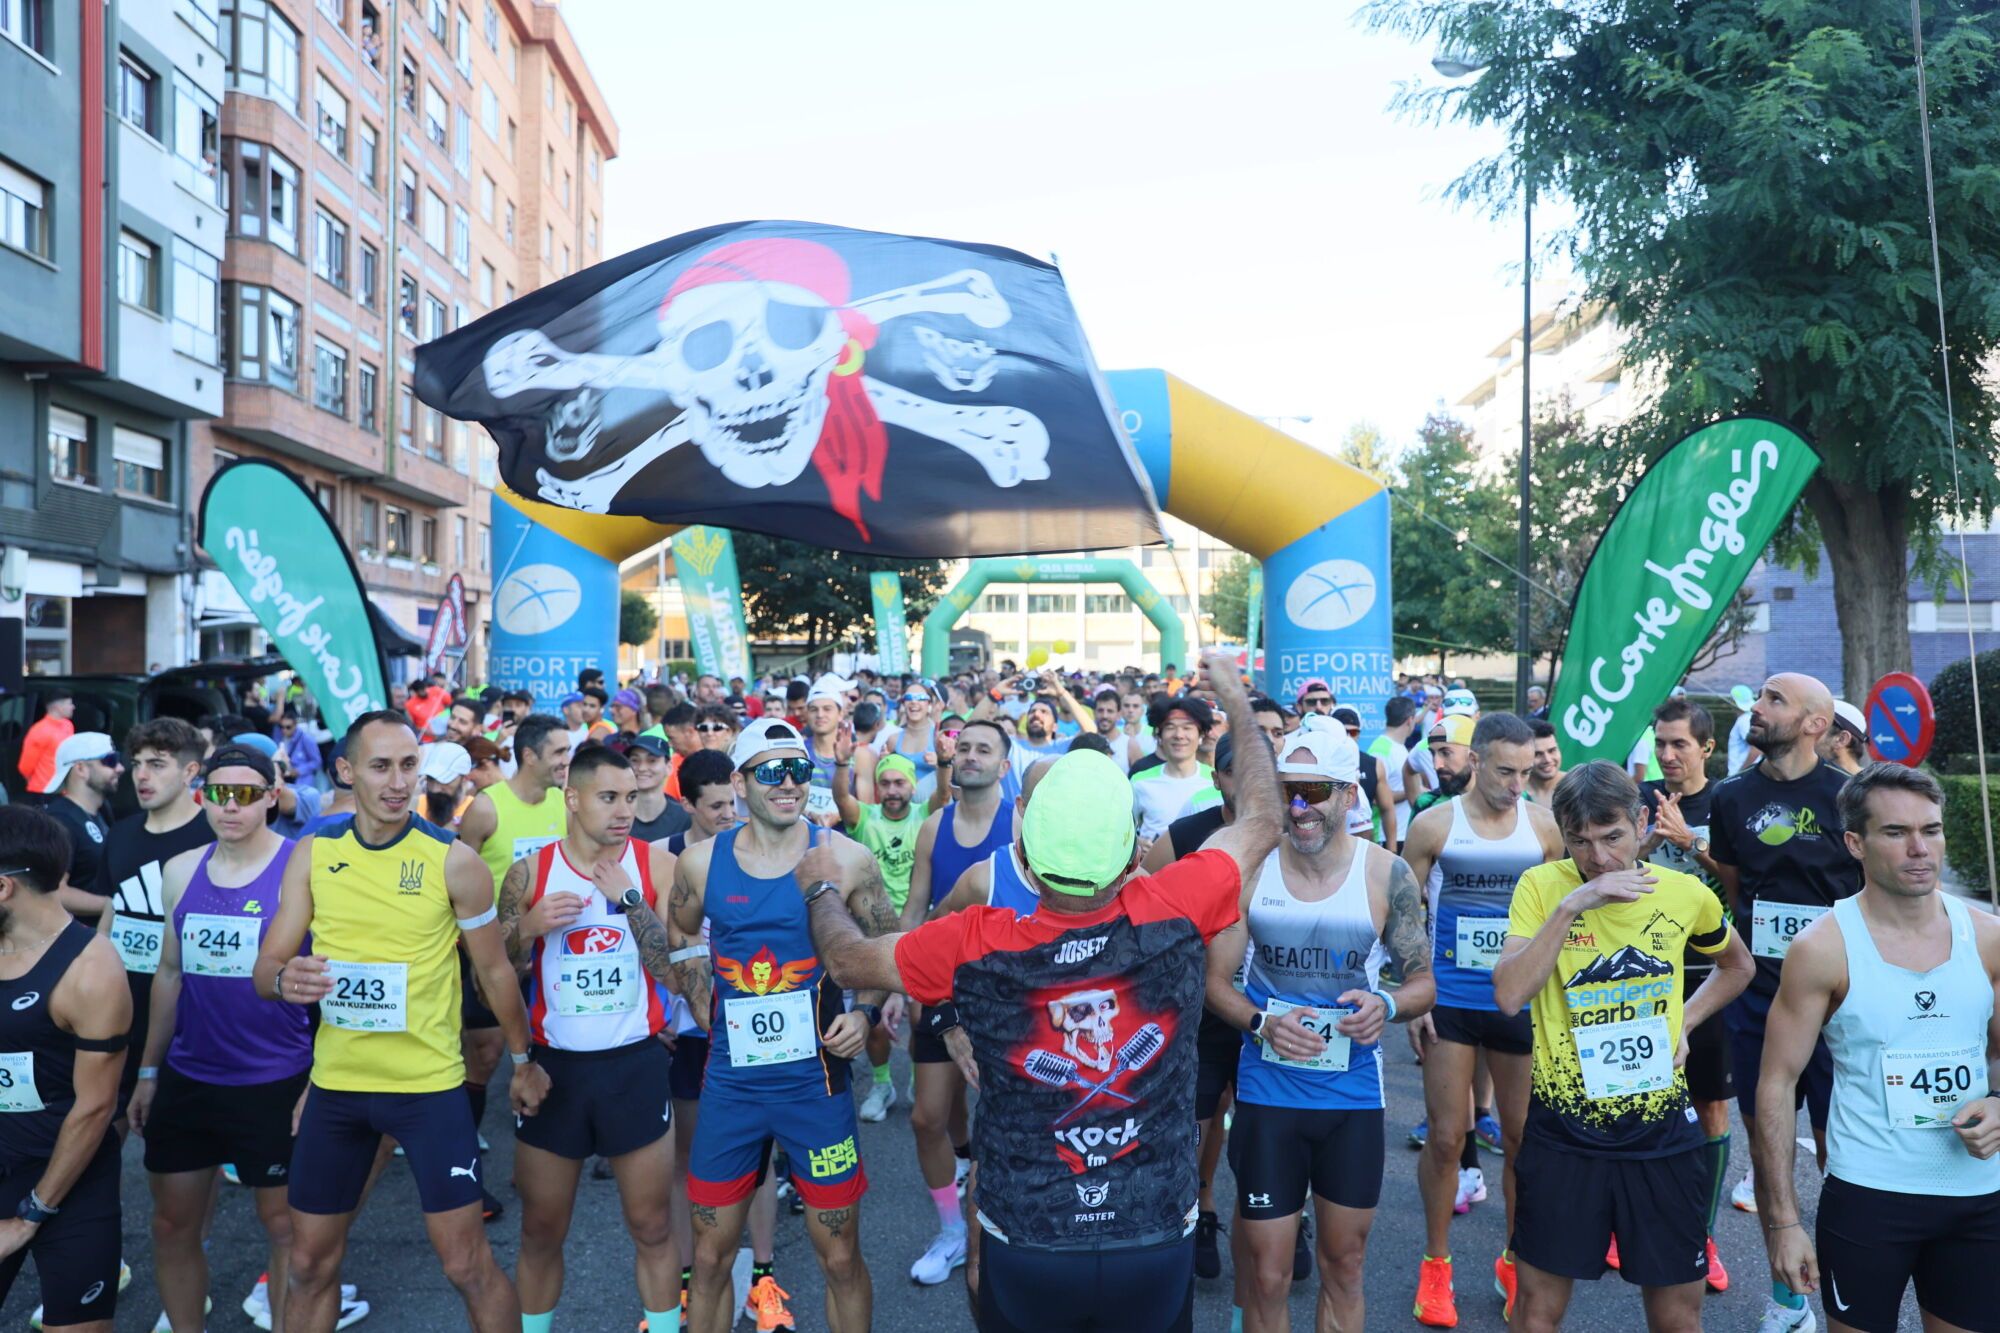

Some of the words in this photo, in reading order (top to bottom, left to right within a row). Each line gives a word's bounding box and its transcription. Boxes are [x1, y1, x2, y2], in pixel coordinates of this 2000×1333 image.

[1563, 694, 1613, 747] El
[1590, 597, 1681, 703] Corte
[1644, 439, 1779, 611] Inglés
[491, 655, 600, 677] DEPORTE
[1281, 652, 1390, 674] DEPORTE
[122, 930, 159, 951] 526
[198, 928, 242, 951] 244
[1262, 944, 1358, 971] CEACTIVO
[576, 966, 623, 990] 514
[1296, 971, 1330, 979] ESPECTRO
[336, 976, 386, 1002] 243
[583, 988, 616, 997] QUIQUE
[1567, 977, 1674, 1008] senderos
[326, 999, 346, 1008] IVAN
[347, 1000, 398, 1010] KUZMENKO
[752, 1010, 785, 1036] 60
[757, 1034, 783, 1044] KAKO
[1599, 1035, 1654, 1065] 259
[1621, 1062, 1641, 1072] IBAI
[1910, 1065, 1971, 1095] 450
[1933, 1094, 1958, 1104] ERIC
[811, 1146, 858, 1178] OCR
[1086, 1153, 1108, 1167] fm
[1074, 1211, 1116, 1223] FASTER
